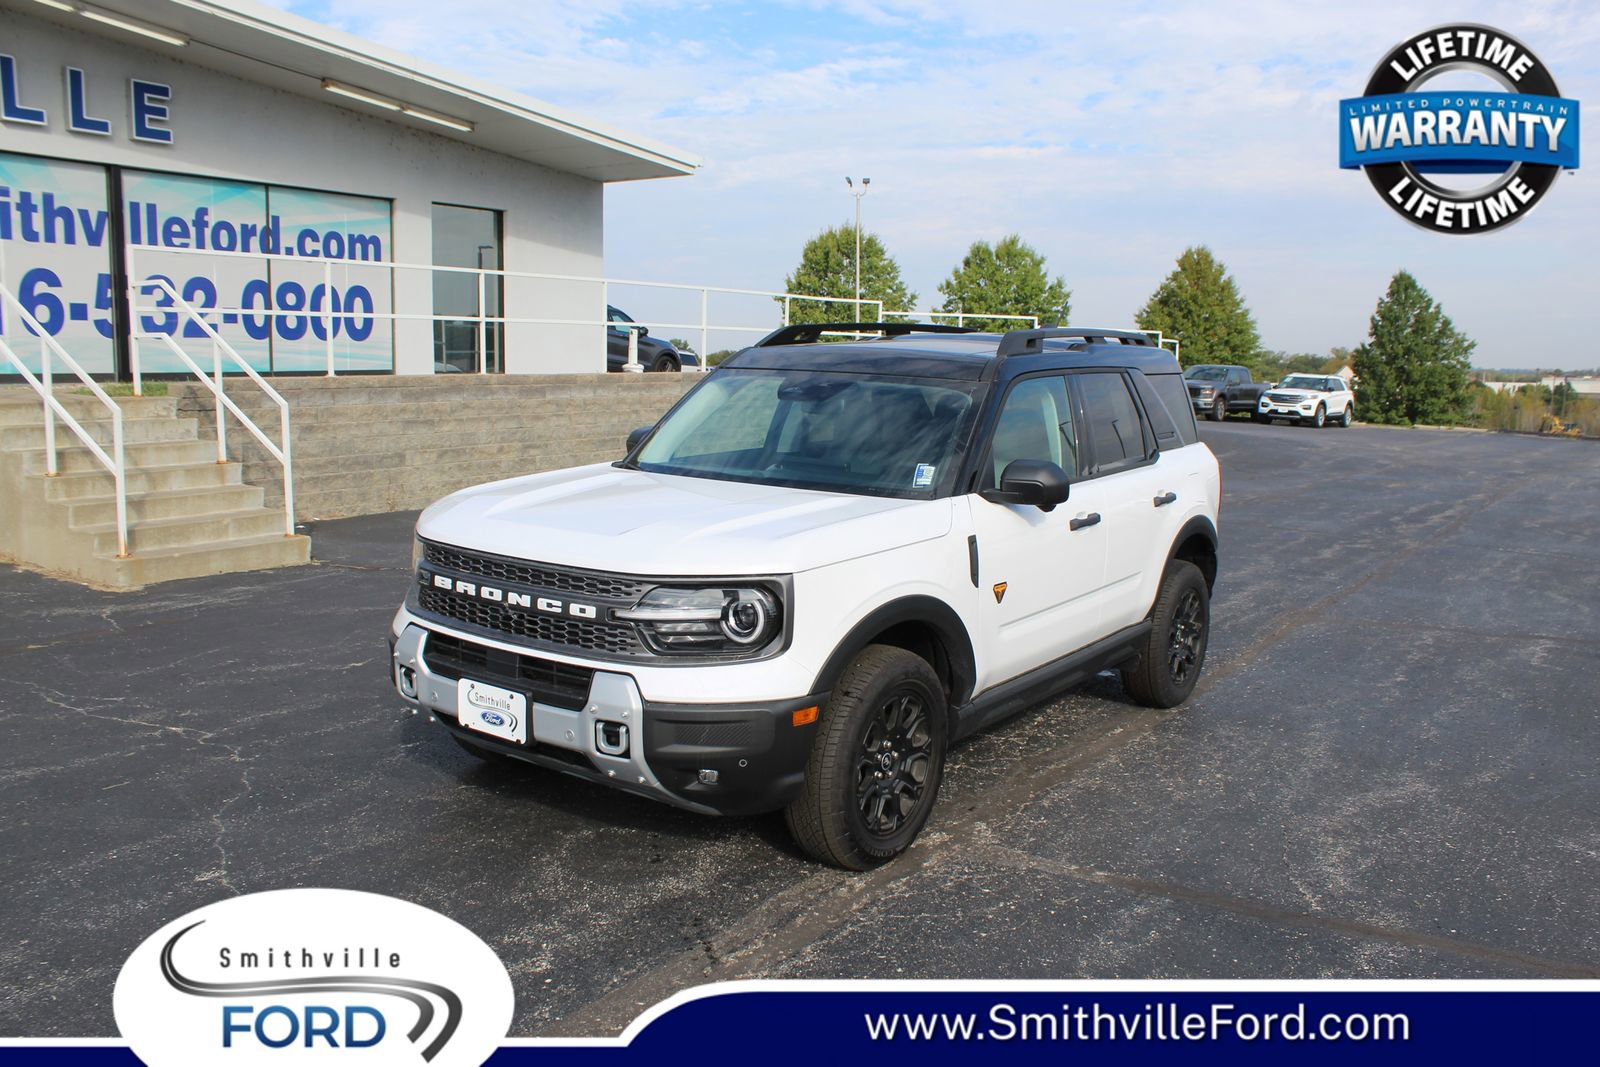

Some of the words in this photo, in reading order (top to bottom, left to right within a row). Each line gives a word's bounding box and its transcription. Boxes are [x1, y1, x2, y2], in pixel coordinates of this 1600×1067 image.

[0, 53, 174, 145] LLE
[0, 185, 382, 262] ithvlleford.com
[433, 574, 597, 619] BRONCO
[474, 692, 511, 711] Smithville
[484, 712, 501, 725] Ford
